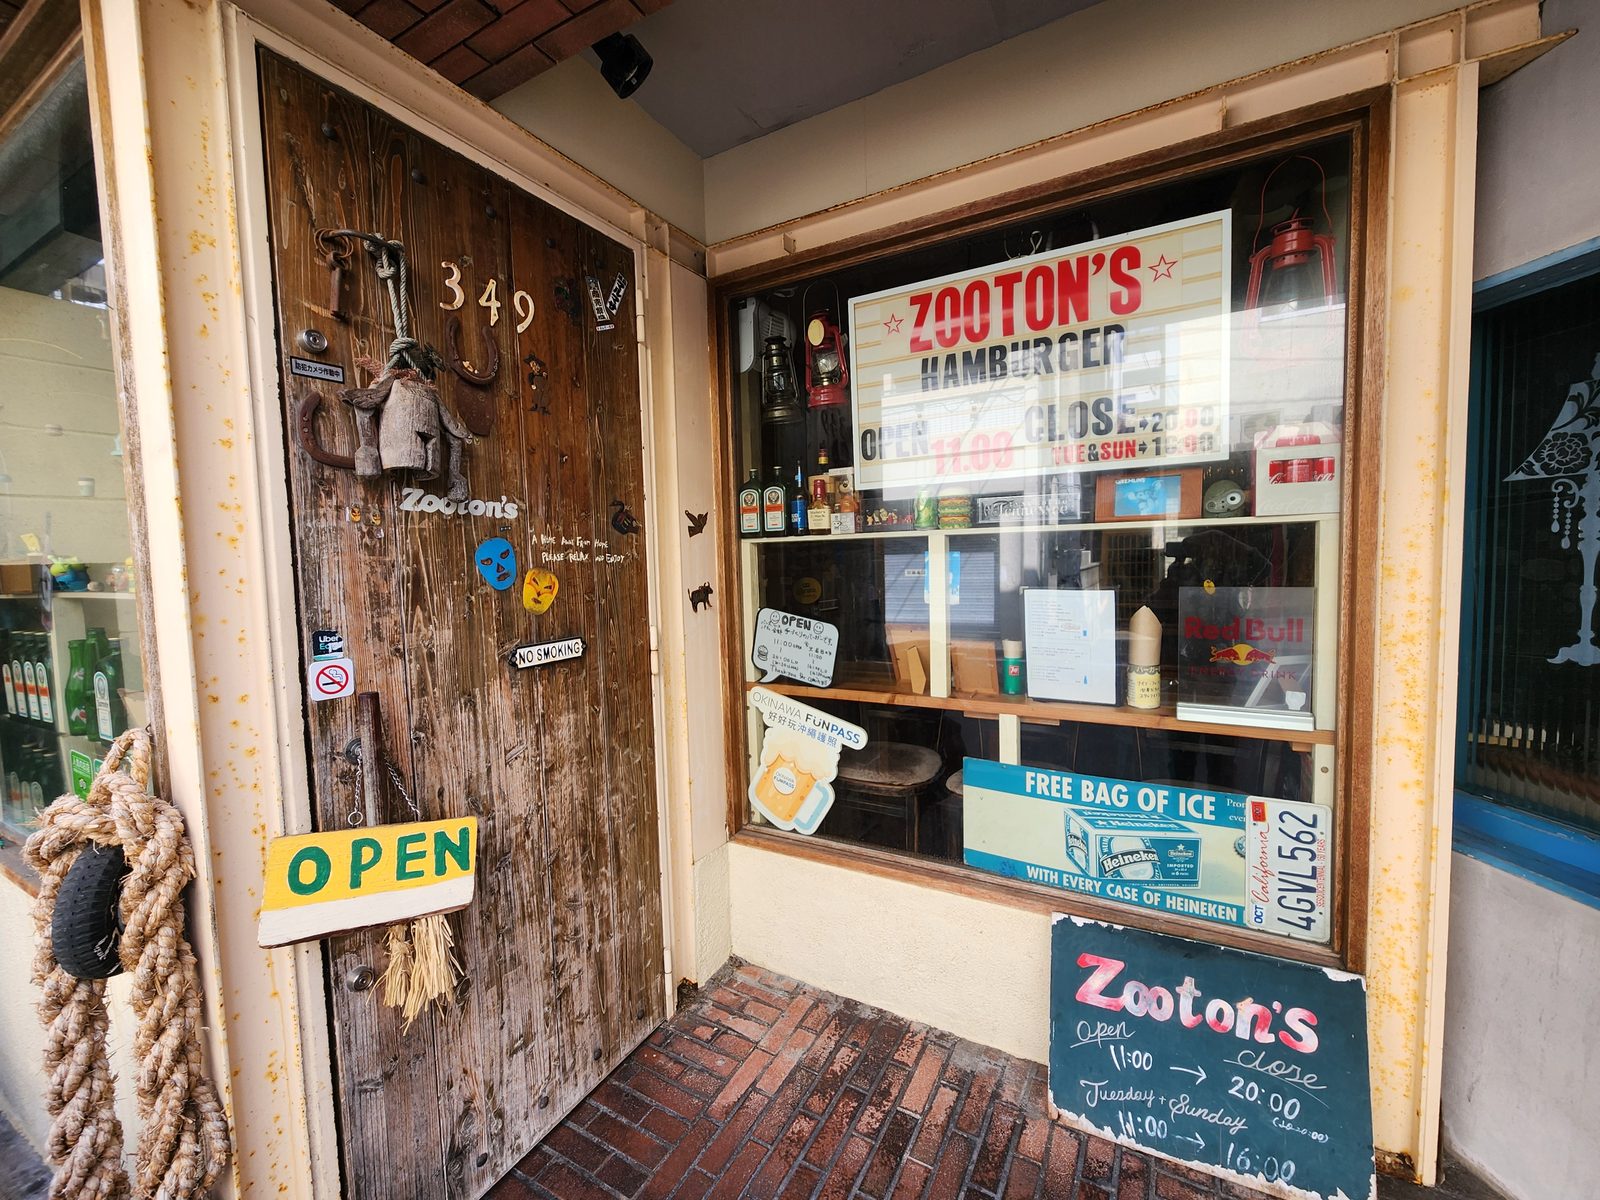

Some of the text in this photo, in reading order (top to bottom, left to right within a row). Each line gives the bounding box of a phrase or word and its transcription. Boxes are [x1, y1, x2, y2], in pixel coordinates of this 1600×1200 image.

[909, 245, 1142, 354] ZOOTON'S
[294, 359, 341, 378] 防犯カメラ作動中
[920, 323, 1126, 393] HAMBURGER
[1024, 395, 1136, 443] CLOSE
[861, 421, 928, 461] OPEN
[400, 488, 518, 519] Zooton's
[542, 551, 565, 563] PLEASE
[569, 551, 589, 563] RELAX
[319, 635, 338, 643] Uber
[781, 614, 812, 631] OPEN
[1183, 616, 1304, 642] Red Bull
[518, 641, 580, 665] NO SMOKING
[752, 691, 801, 720] OKINAWA
[1025, 771, 1216, 821] FREE BAG OF ICE
[287, 826, 471, 895] OPEN
[1251, 823, 1275, 904] California
[1277, 810, 1318, 932] 4GVL562
[1026, 865, 1059, 884] WITH
[1063, 873, 1102, 893] EVERY
[1106, 883, 1139, 902] CASE
[1142, 891, 1161, 906] OF
[1166, 895, 1237, 920] HEINEKEN
[1254, 904, 1264, 924] OCT
[1075, 952, 1320, 1054] Zooton's
[1076, 1020, 1136, 1047] Open
[1109, 1045, 1153, 1071] 11:00
[1080, 1079, 1155, 1109] Tuesday
[1168, 1093, 1248, 1135] Sunday
[1228, 1075, 1301, 1120] 20:00
[1118, 1110, 1168, 1139] 11:00
[1226, 1141, 1297, 1183] 16:00
